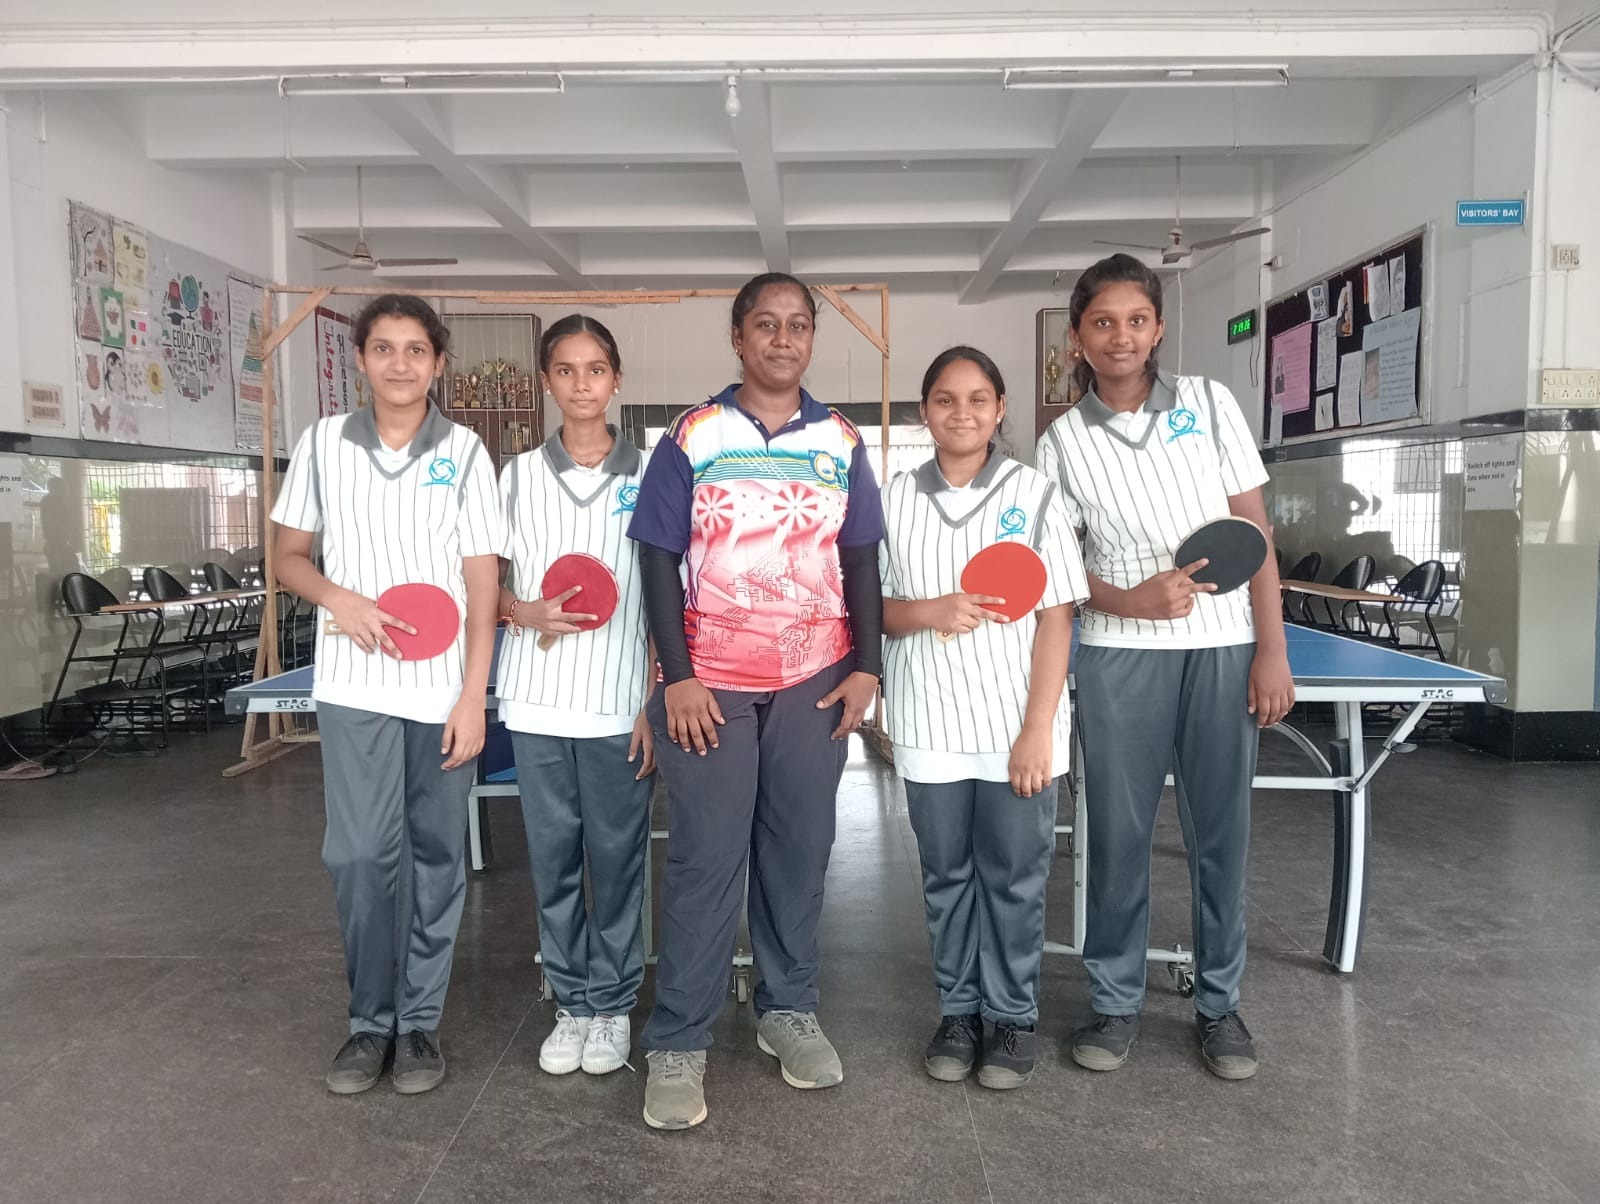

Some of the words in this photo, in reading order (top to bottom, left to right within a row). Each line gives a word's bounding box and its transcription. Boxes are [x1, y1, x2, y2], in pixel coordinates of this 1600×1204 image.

[1460, 209, 1501, 218] VISITORS'
[1502, 208, 1519, 217] BAY
[172, 329, 213, 354] EDUCATION
